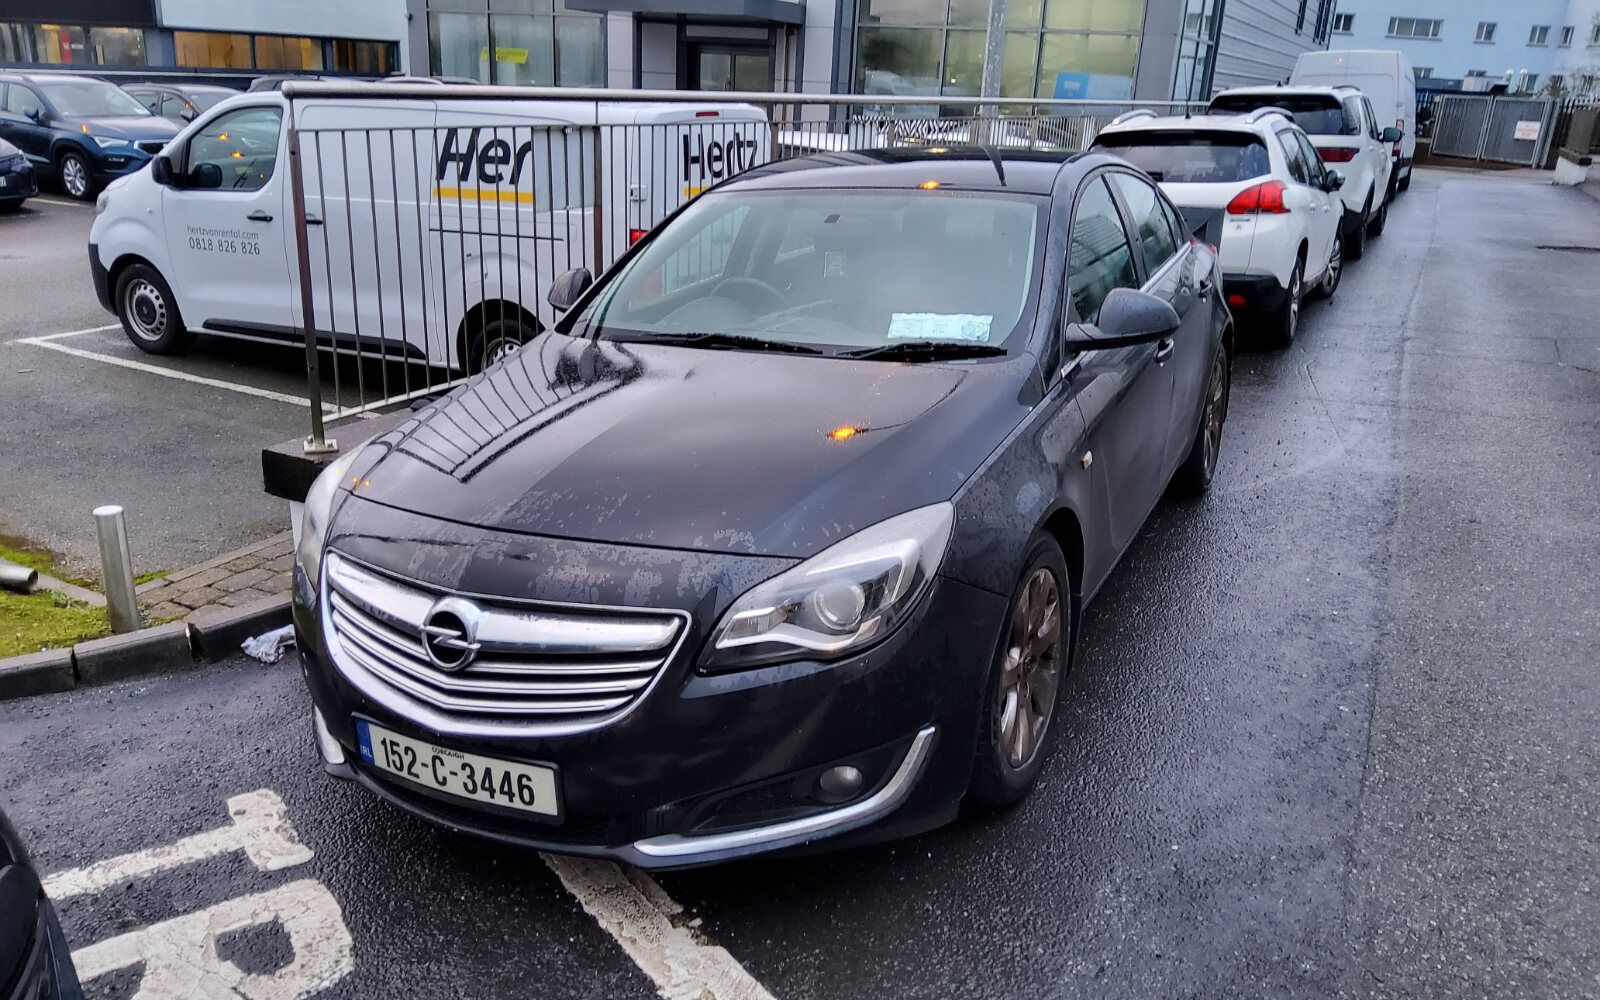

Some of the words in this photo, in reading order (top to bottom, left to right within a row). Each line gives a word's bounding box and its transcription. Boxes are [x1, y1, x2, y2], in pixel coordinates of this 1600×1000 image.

[683, 132, 757, 181] Hertz
[187, 224, 259, 240] hertzvanrental.com
[189, 237, 214, 251] 0818
[218, 239, 237, 253] 826
[240, 241, 260, 255] 826
[381, 737, 535, 806] 152-C-3446
